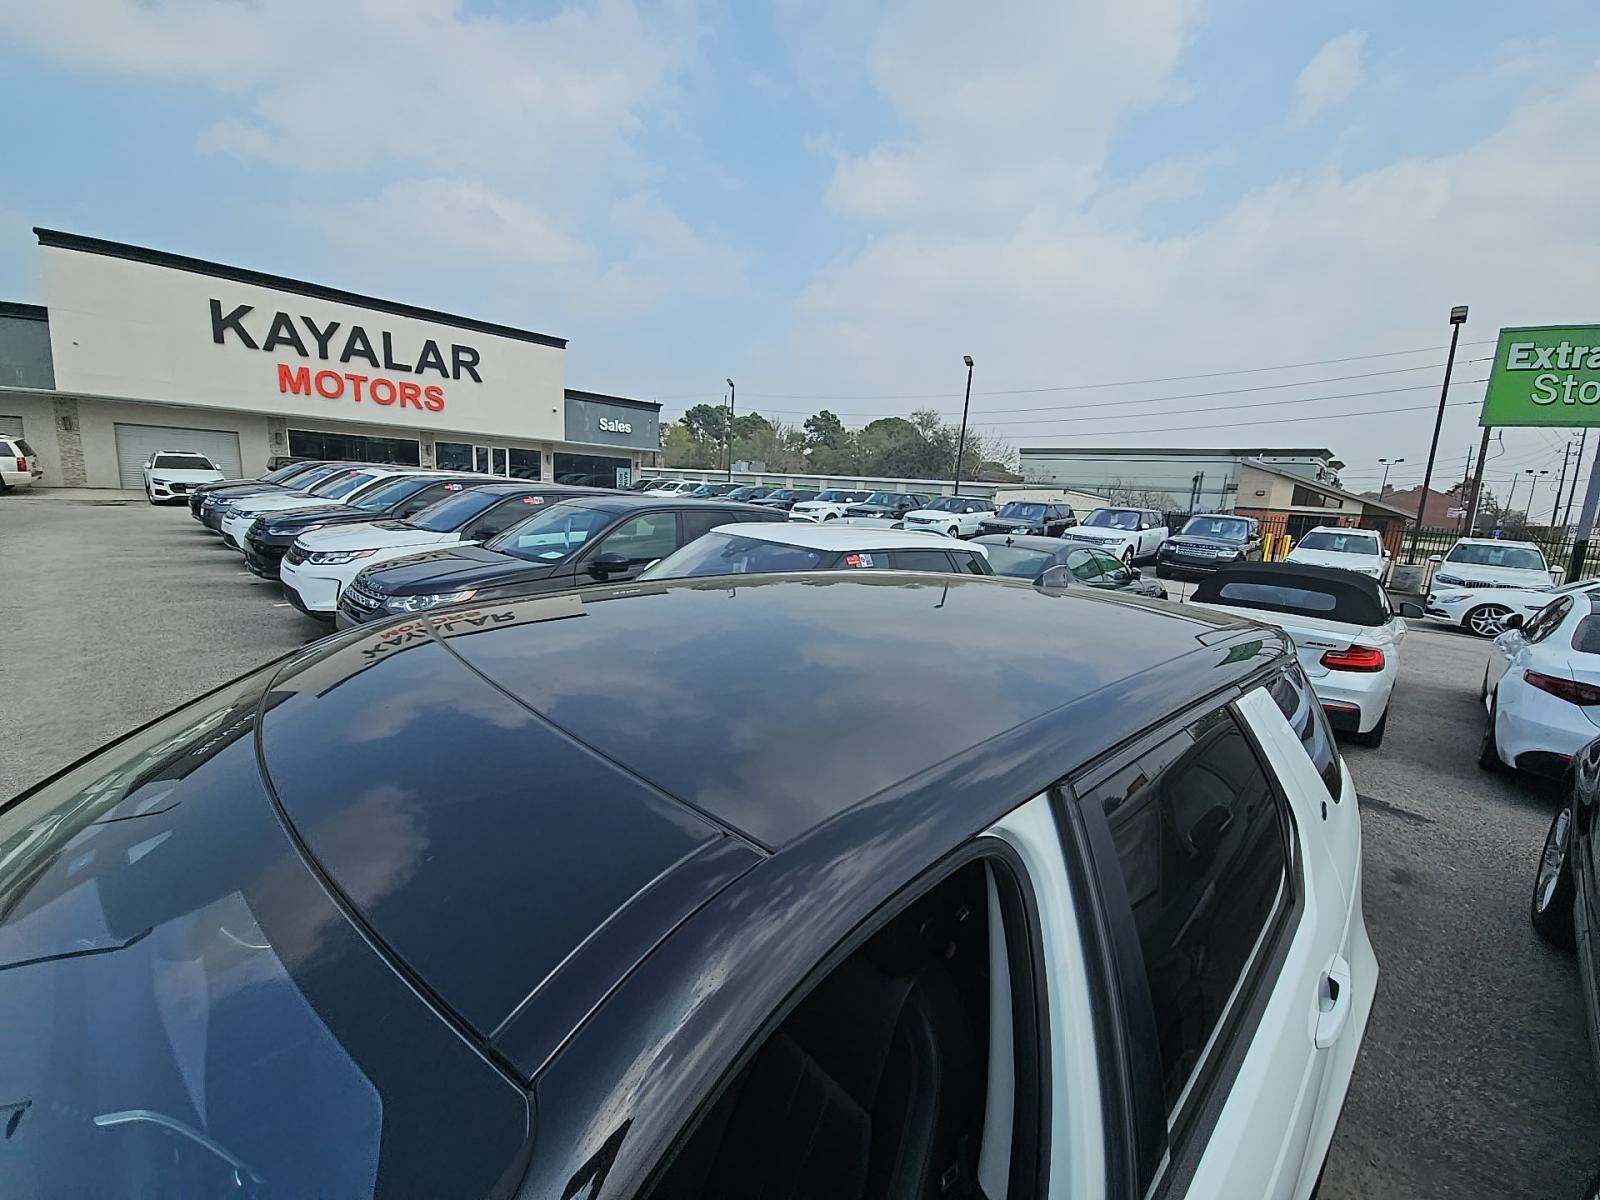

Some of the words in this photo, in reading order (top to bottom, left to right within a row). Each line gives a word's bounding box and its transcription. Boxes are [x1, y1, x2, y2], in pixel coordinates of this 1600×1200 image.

[209, 298, 483, 384] KAYALAR
[277, 363, 445, 412] MOTORS
[599, 417, 632, 433] Sales
